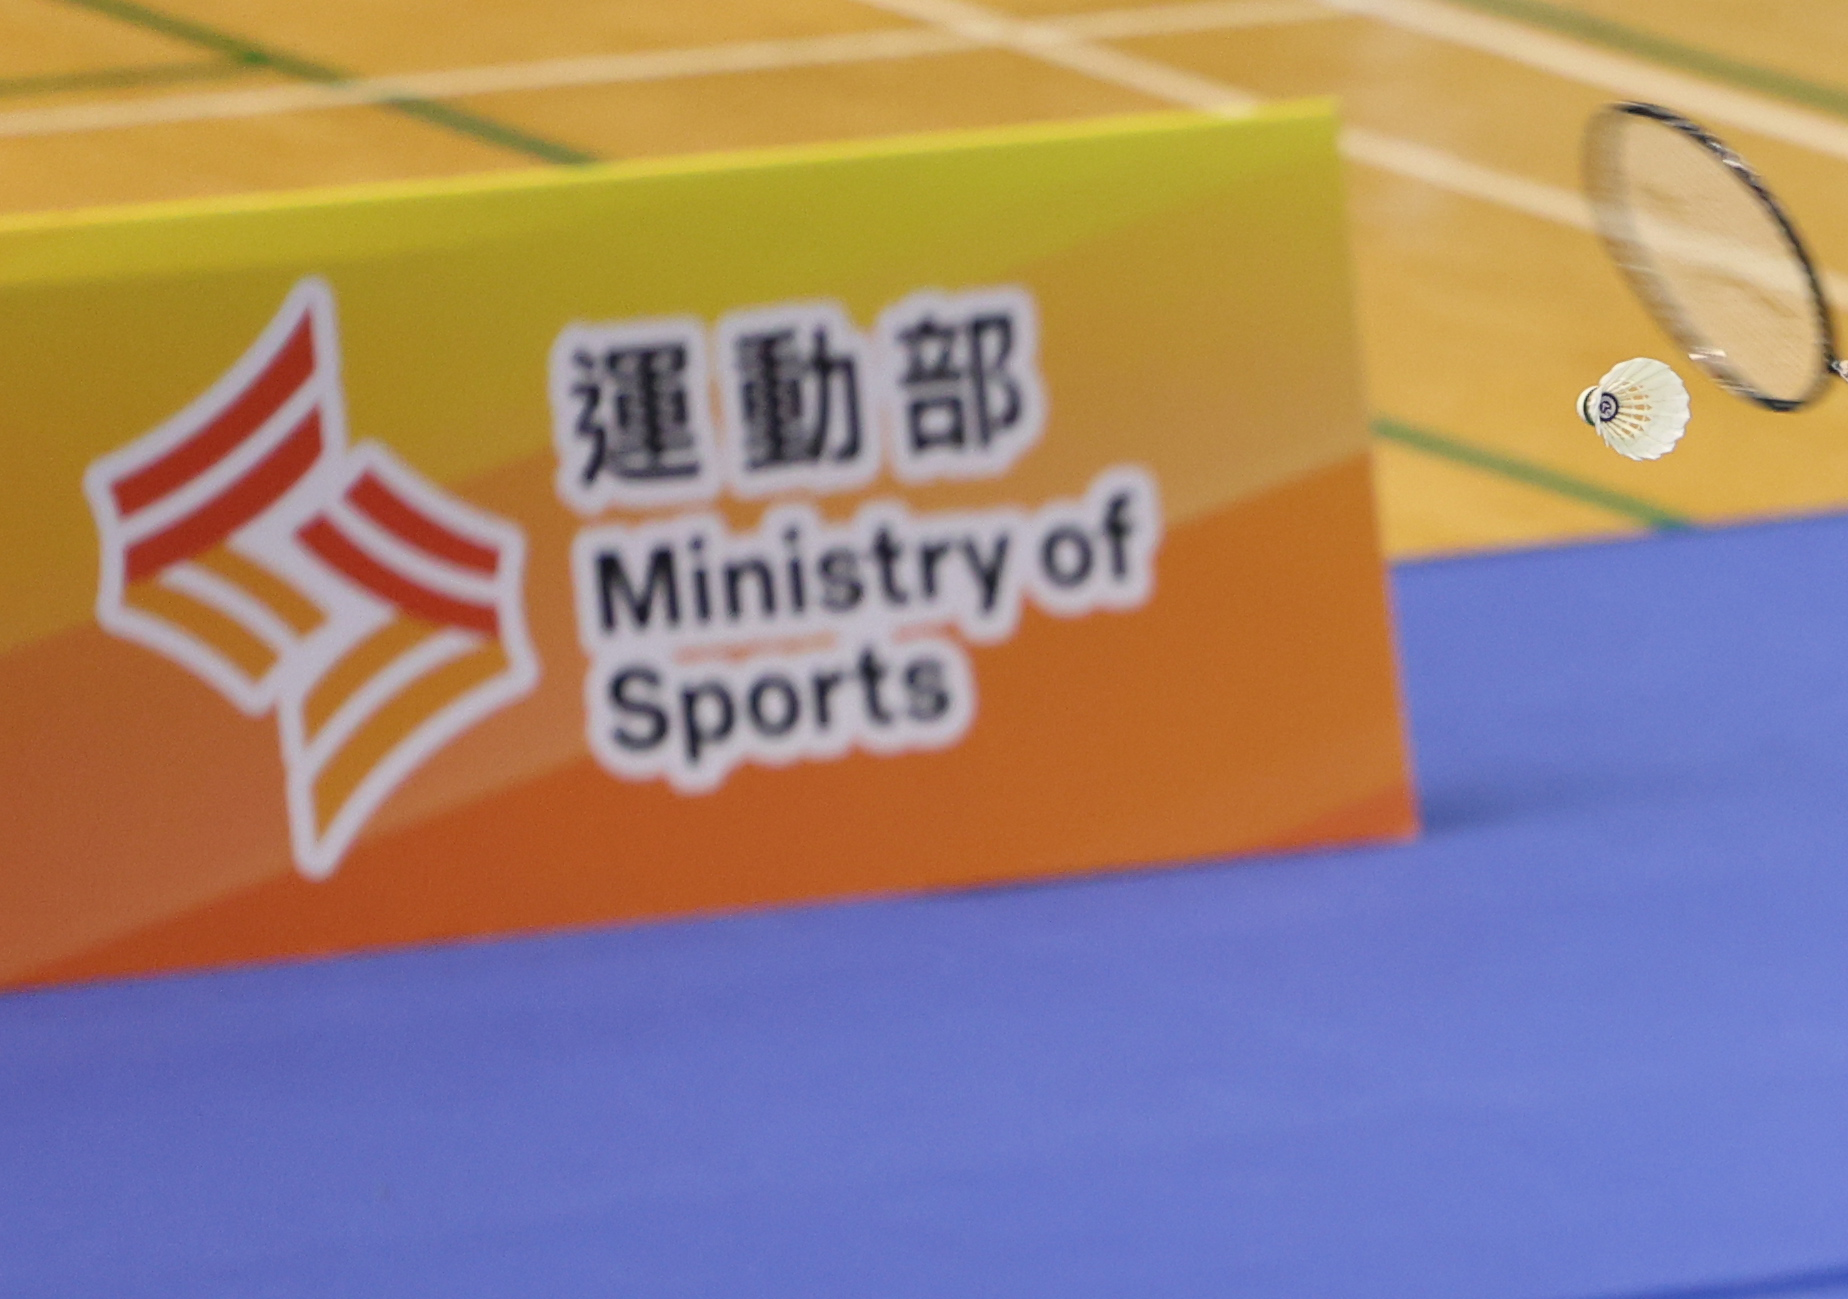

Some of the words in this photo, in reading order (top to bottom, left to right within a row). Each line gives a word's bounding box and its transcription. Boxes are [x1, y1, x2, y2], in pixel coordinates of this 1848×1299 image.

[568, 308, 1028, 490] 運動部
[596, 524, 1009, 634] Ministry
[1038, 489, 1138, 590] of
[606, 650, 955, 761] Sports
